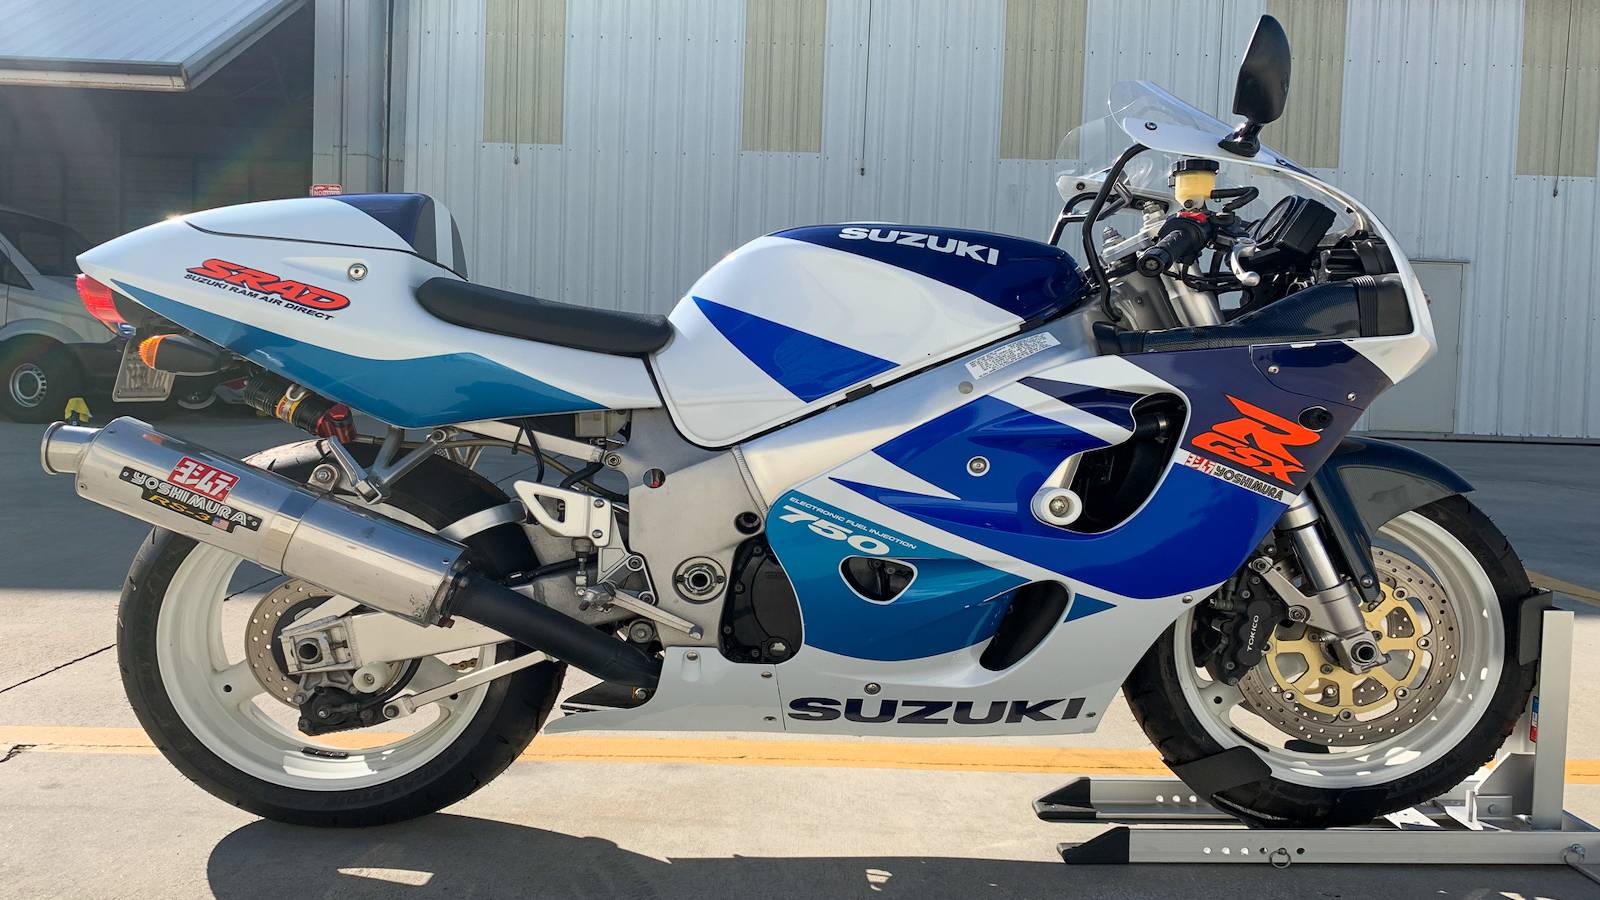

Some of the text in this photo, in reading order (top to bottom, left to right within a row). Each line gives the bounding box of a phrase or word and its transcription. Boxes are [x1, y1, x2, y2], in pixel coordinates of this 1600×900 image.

[838, 227, 999, 266] SUZUKI
[184, 274, 335, 321] SUZUKI RAM AIR DIRECT
[186, 258, 351, 311] SRAD
[130, 471, 247, 526] YOSHIMURA
[1214, 465, 1284, 501] YOSHIMURA
[149, 495, 210, 521] RS-3
[789, 496, 917, 550] ELECTRONIC FUEL INJECTION
[779, 505, 890, 555] 750
[1246, 615, 1259, 652] TOKICO
[787, 697, 1086, 724] SUZUKI
